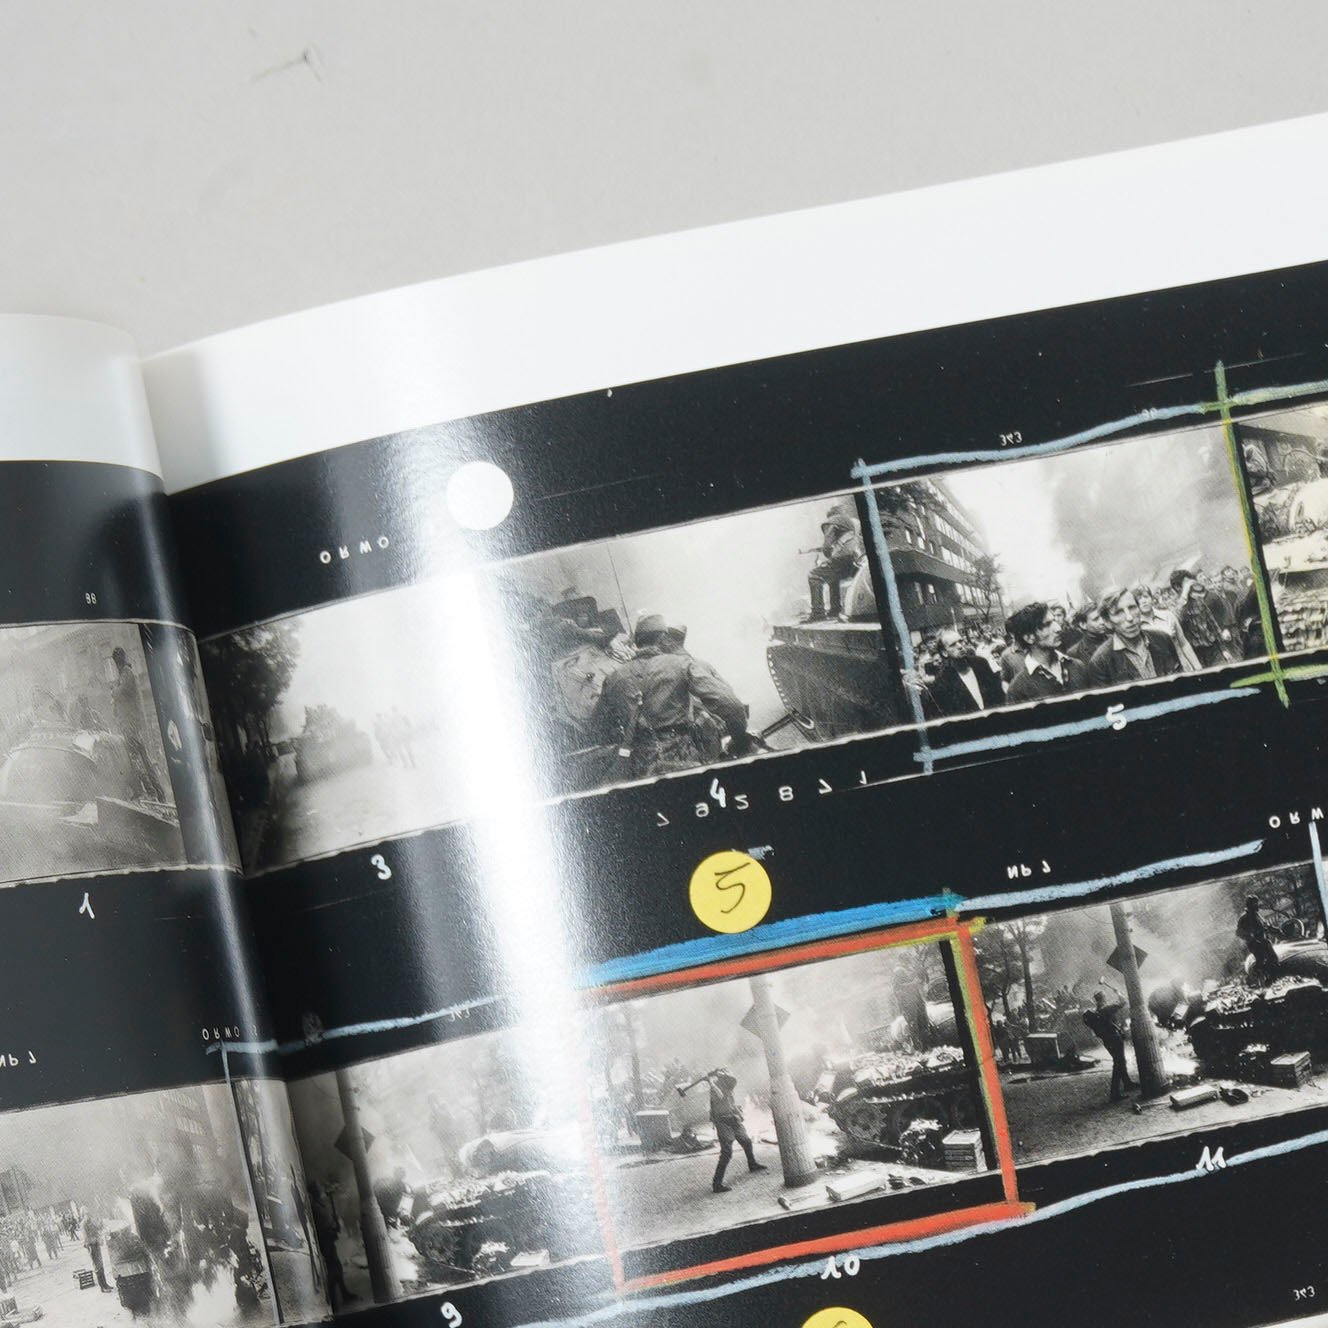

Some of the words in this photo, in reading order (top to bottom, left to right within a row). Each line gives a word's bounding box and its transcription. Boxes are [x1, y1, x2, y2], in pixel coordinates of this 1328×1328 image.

[1106, 705, 1127, 730] 5
[708, 779, 727, 808] 4
[369, 854, 392, 881] 3
[713, 861, 751, 915] 5
[79, 892, 95, 920] 1
[1196, 1146, 1227, 1172] 11
[820, 1256, 861, 1281] 10
[440, 1301, 463, 1328] 9
